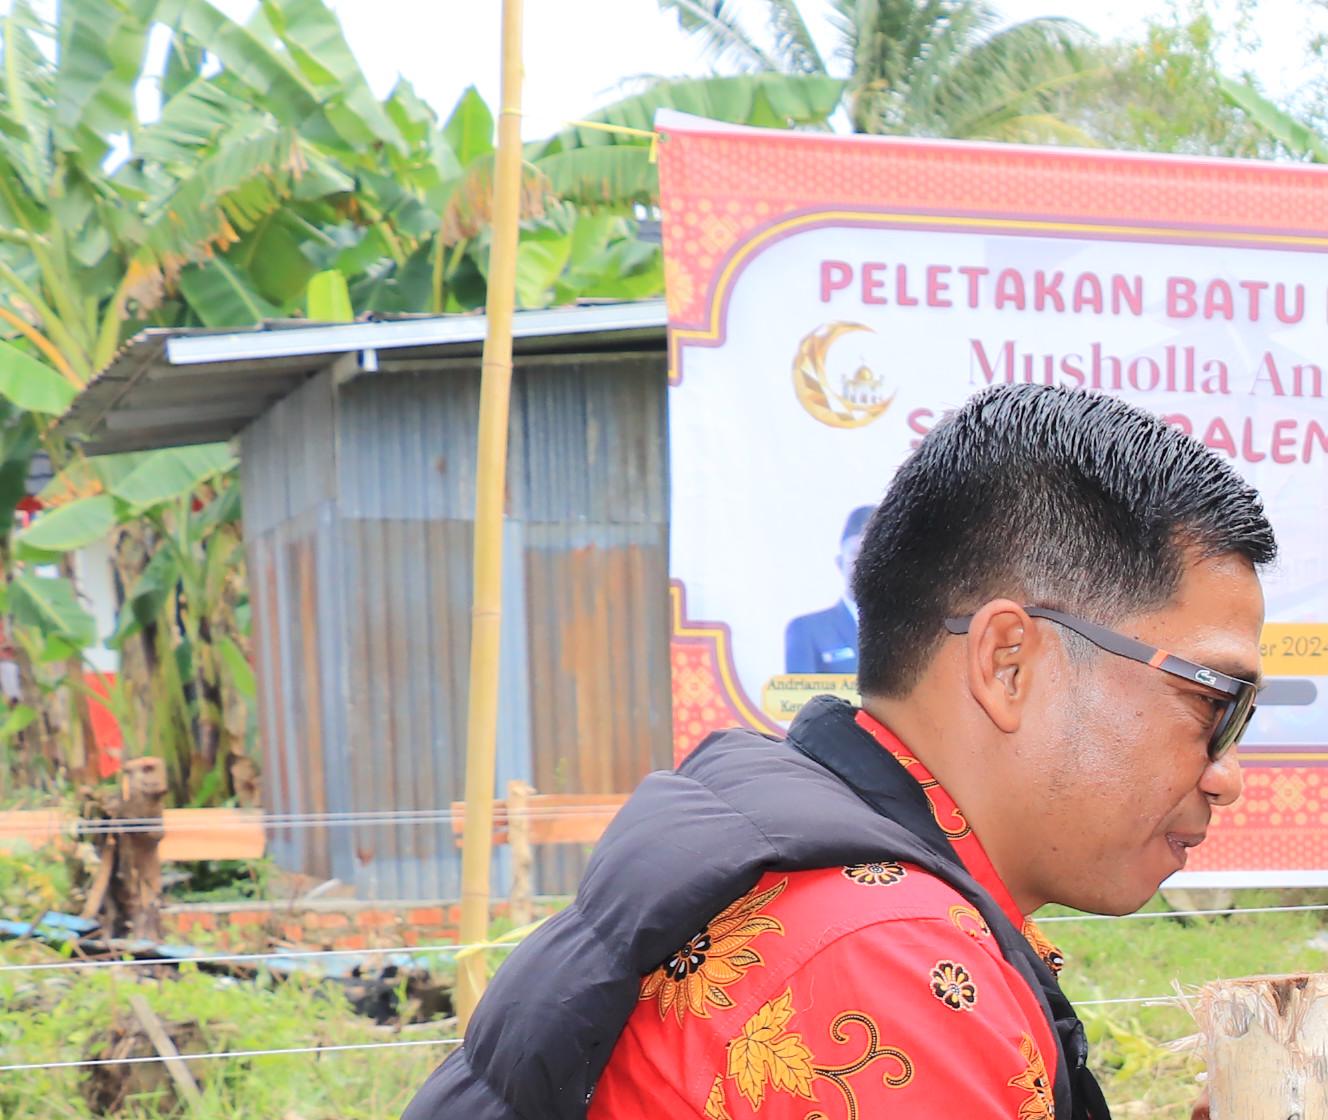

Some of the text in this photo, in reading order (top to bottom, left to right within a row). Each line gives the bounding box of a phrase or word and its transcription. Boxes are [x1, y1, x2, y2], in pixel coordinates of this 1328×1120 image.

[820, 260, 1143, 316] PELETAKAN
[1165, 276, 1305, 324] BATU
[968, 338, 1231, 396] Musholla
[1249, 350, 1324, 398] An
